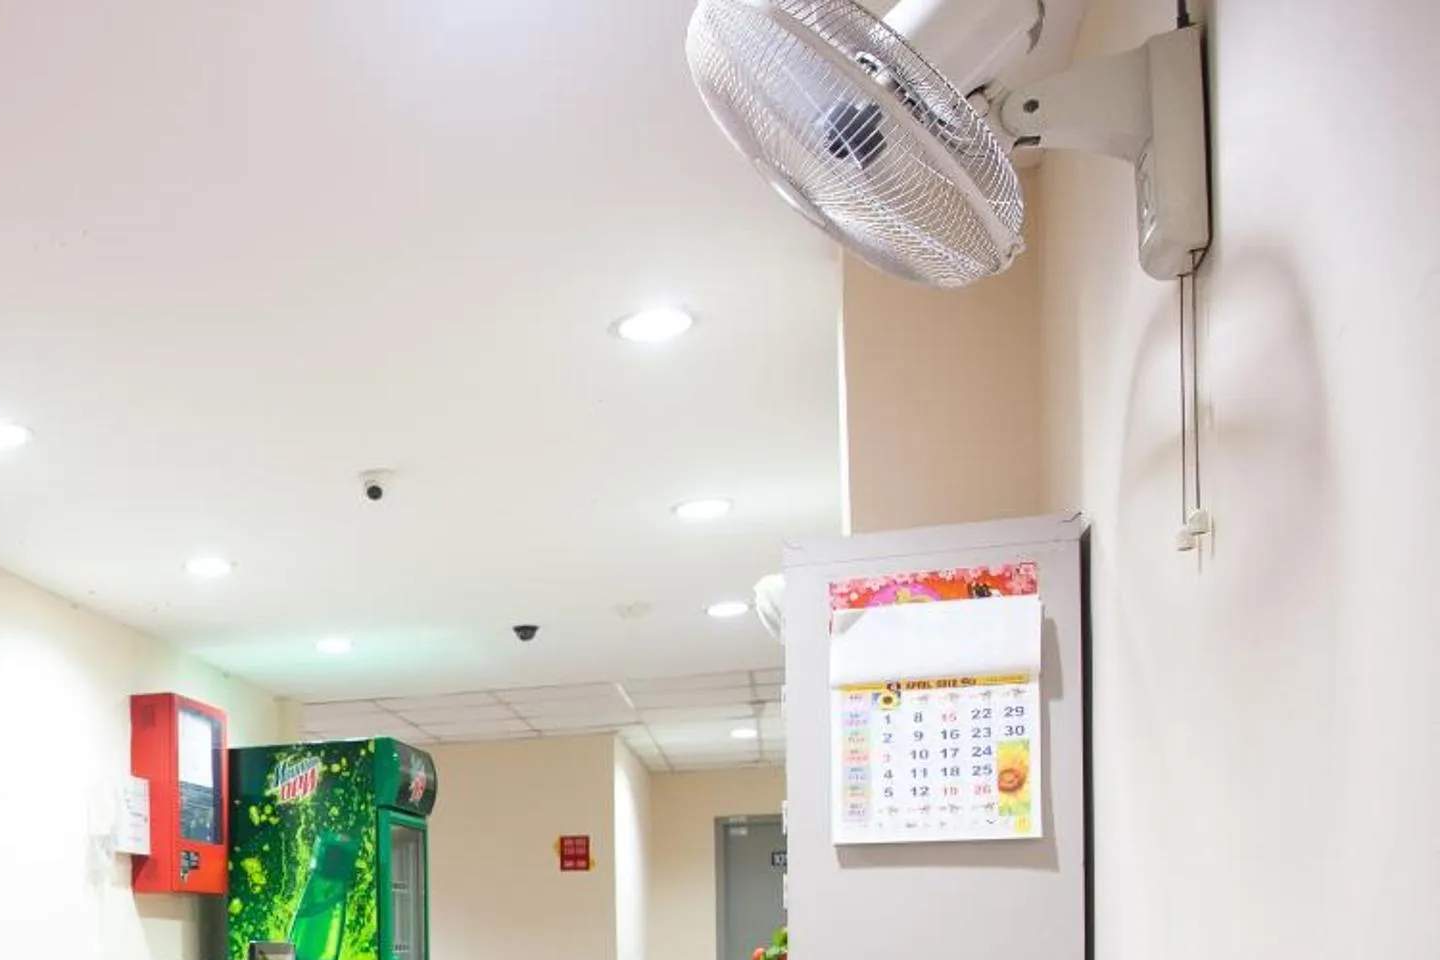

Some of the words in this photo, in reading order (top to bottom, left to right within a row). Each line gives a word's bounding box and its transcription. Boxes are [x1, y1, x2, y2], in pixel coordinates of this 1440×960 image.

[884, 715, 891, 724] 1
[914, 712, 923, 723] 8
[942, 713, 957, 722] 15
[971, 708, 992, 719] 22
[1003, 706, 1025, 717] 29
[883, 733, 893, 743] 2
[914, 731, 924, 741] 9
[941, 729, 960, 740] 16
[972, 727, 992, 738] 23
[1004, 725, 1025, 736] 30
[911, 750, 928, 760] 10
[940, 748, 959, 758] 17
[971, 746, 992, 757] 24
[883, 769, 893, 779] 4
[911, 768, 927, 778] 11
[941, 766, 959, 776] 18
[972, 765, 992, 776] 25
[884, 787, 893, 797] 5
[910, 786, 929, 797] 12
[974, 785, 991, 794] 26
